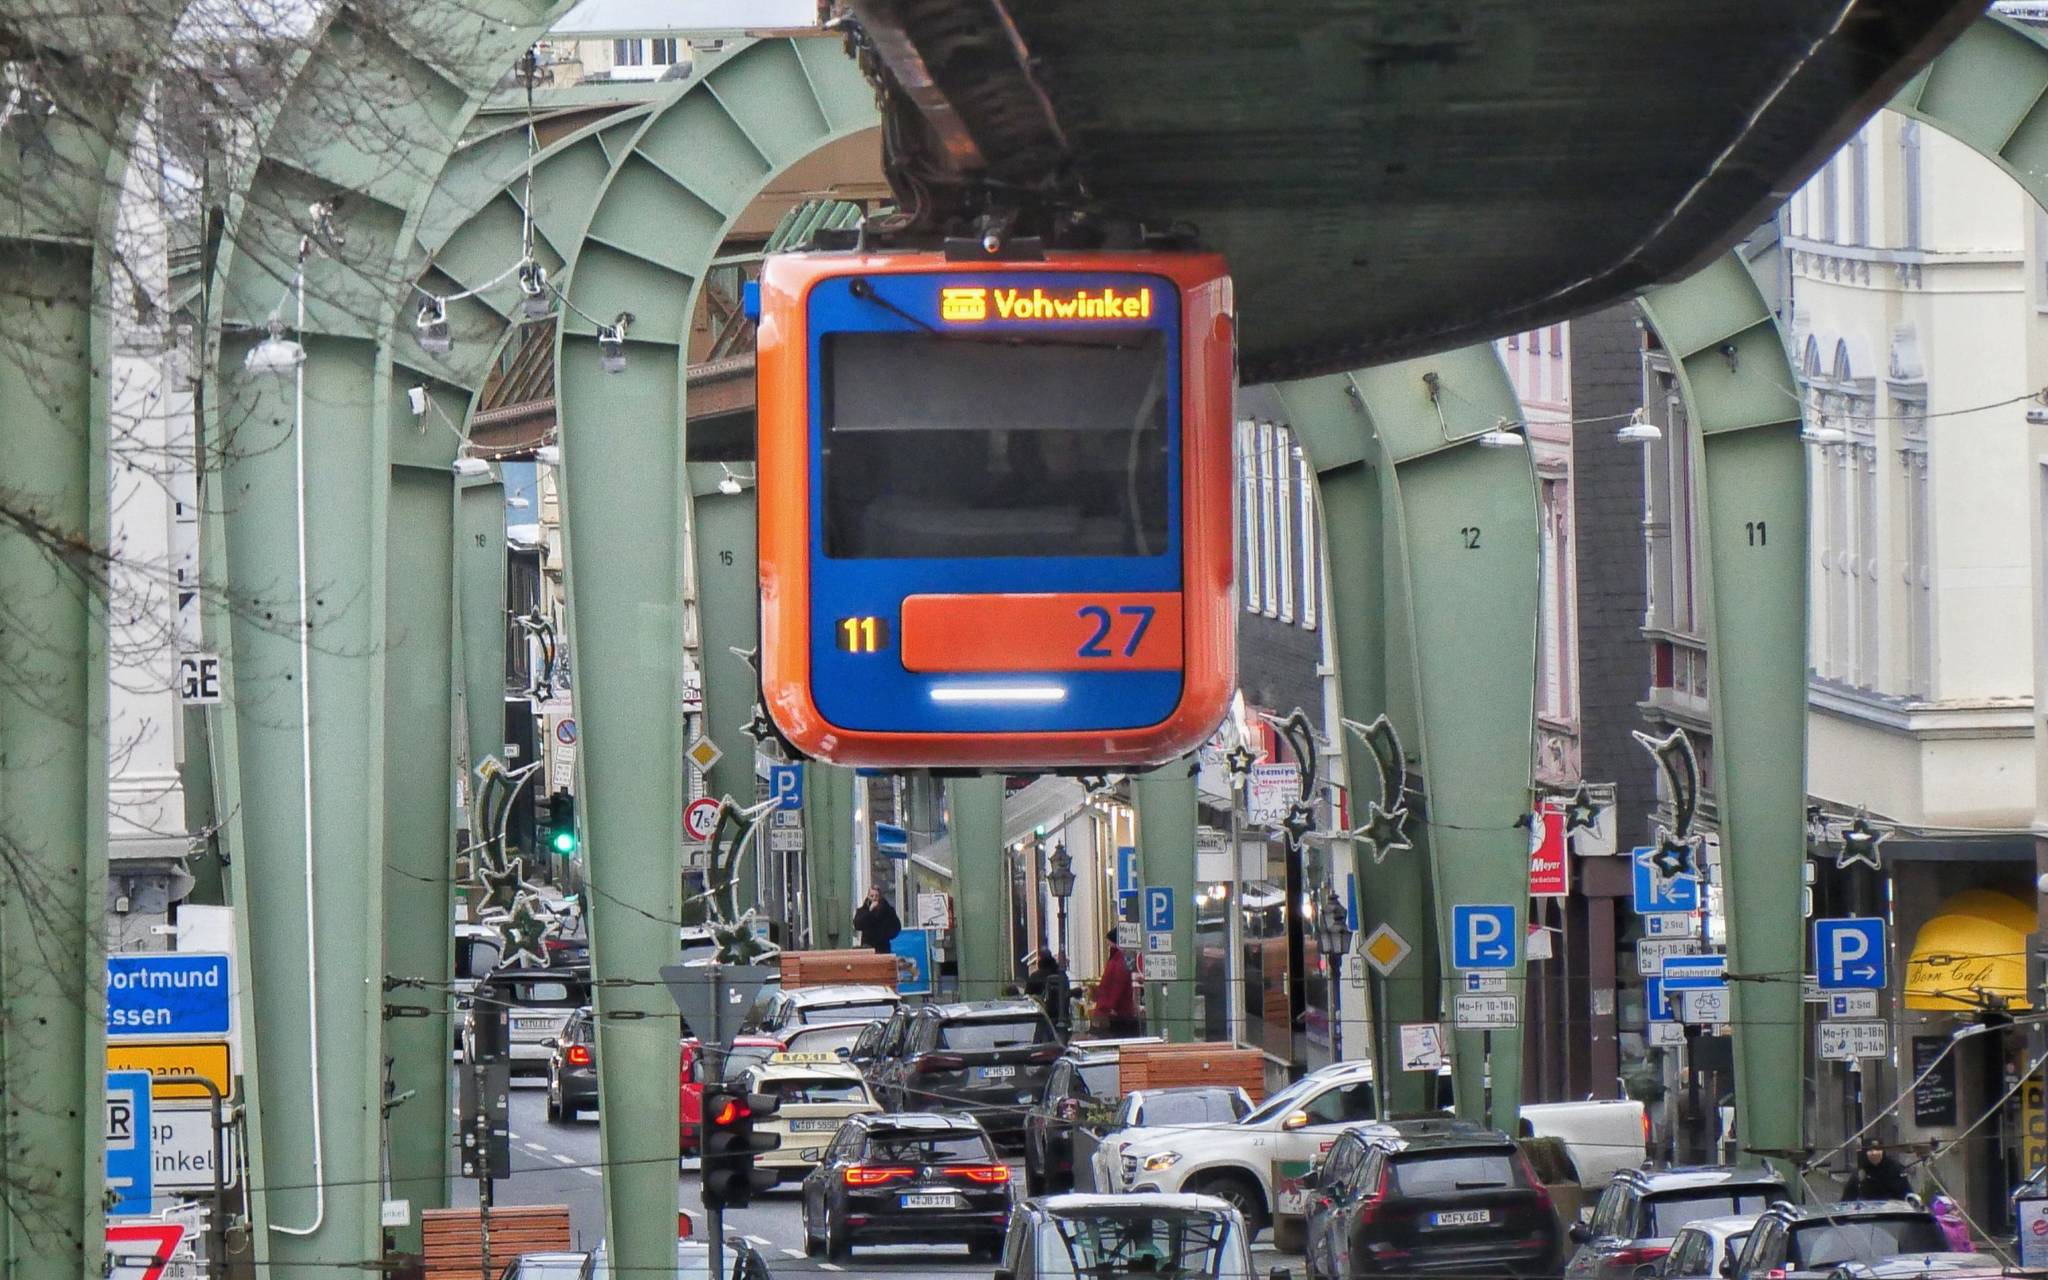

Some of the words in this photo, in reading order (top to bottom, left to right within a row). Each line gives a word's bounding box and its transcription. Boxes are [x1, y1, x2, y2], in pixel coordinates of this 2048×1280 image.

[993, 288, 1150, 318] Vohwinkel
[1461, 527, 1481, 549] 12
[1746, 522, 1766, 546] 11
[843, 617, 877, 653] 11
[1076, 606, 1156, 657] 27
[778, 771, 796, 804] P
[1151, 892, 1168, 927] P
[1468, 913, 1501, 960] P
[1832, 928, 1868, 981] P
[1459, 1001, 1482, 1011] Mo-Fr
[1823, 1027, 1849, 1039] Mo-Fr
[1824, 1042, 1835, 1054] Sa
[783, 1052, 823, 1062] TAXI
